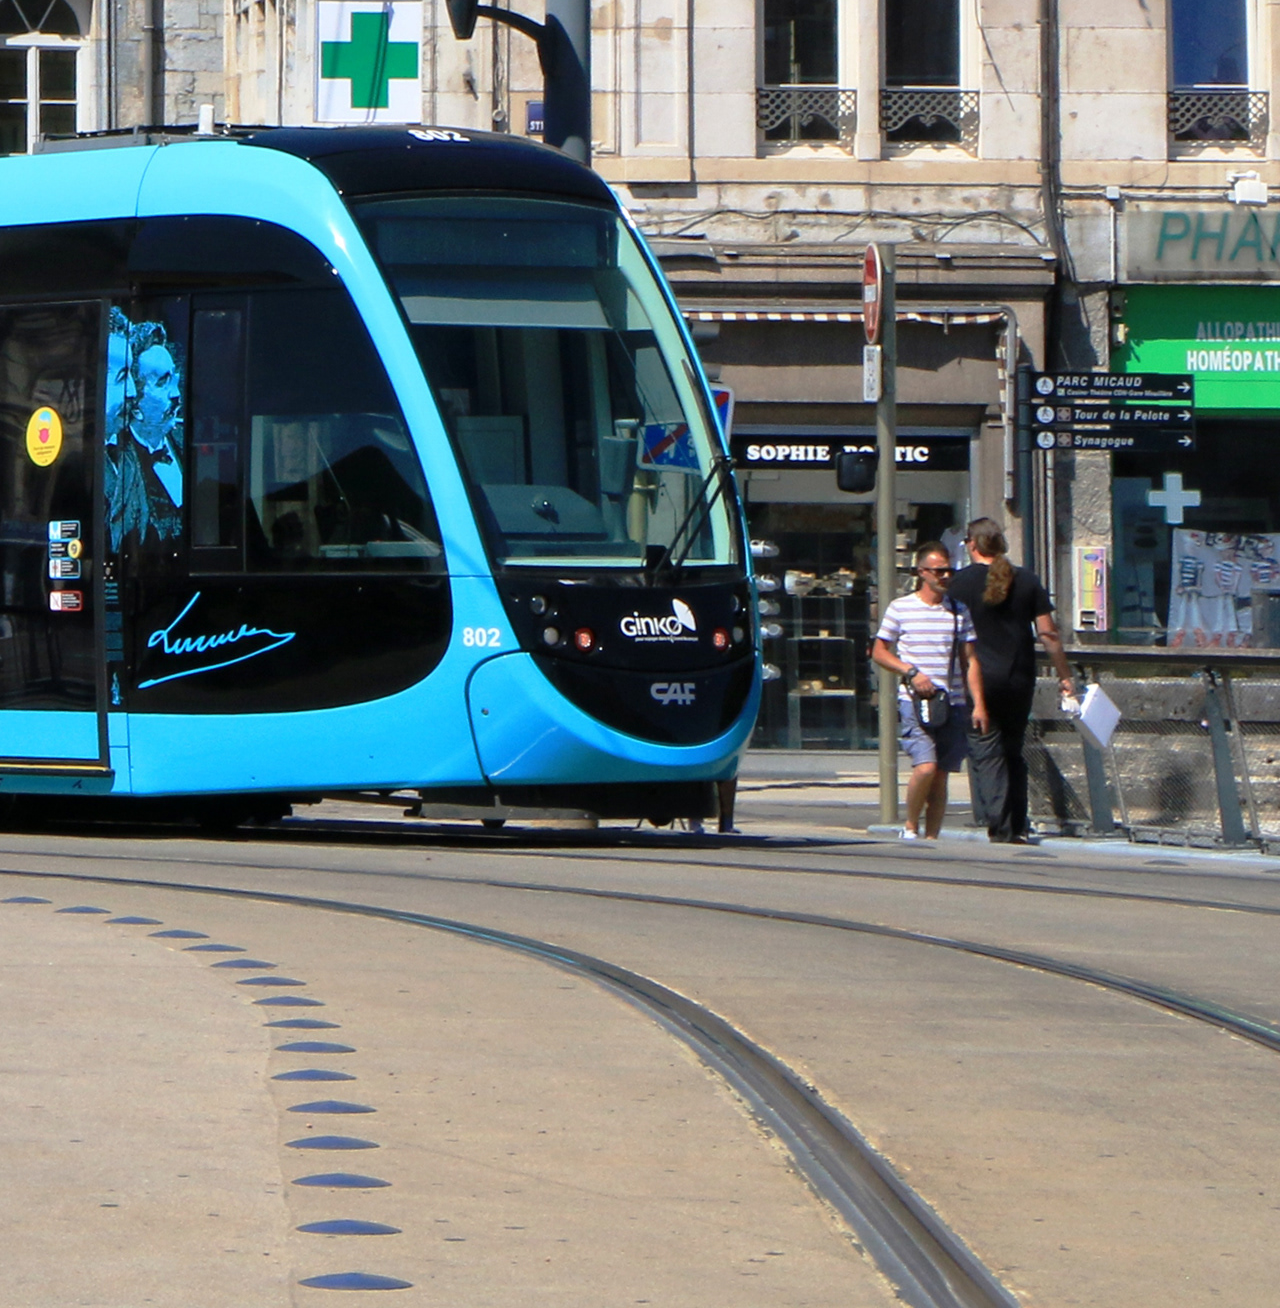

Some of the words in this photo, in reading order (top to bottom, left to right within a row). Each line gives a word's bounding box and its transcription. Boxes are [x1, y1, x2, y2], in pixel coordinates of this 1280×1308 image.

[1056, 376, 1089, 387] PARC
[1093, 376, 1143, 387] MICAUD
[1074, 409, 1099, 420] Tour
[1102, 409, 1116, 420] de
[1120, 409, 1131, 420] la
[1134, 410, 1170, 421] Pelote
[1074, 435, 1134, 448] Synagogue
[746, 445, 831, 462] SOPHIE
[463, 627, 501, 647] 802
